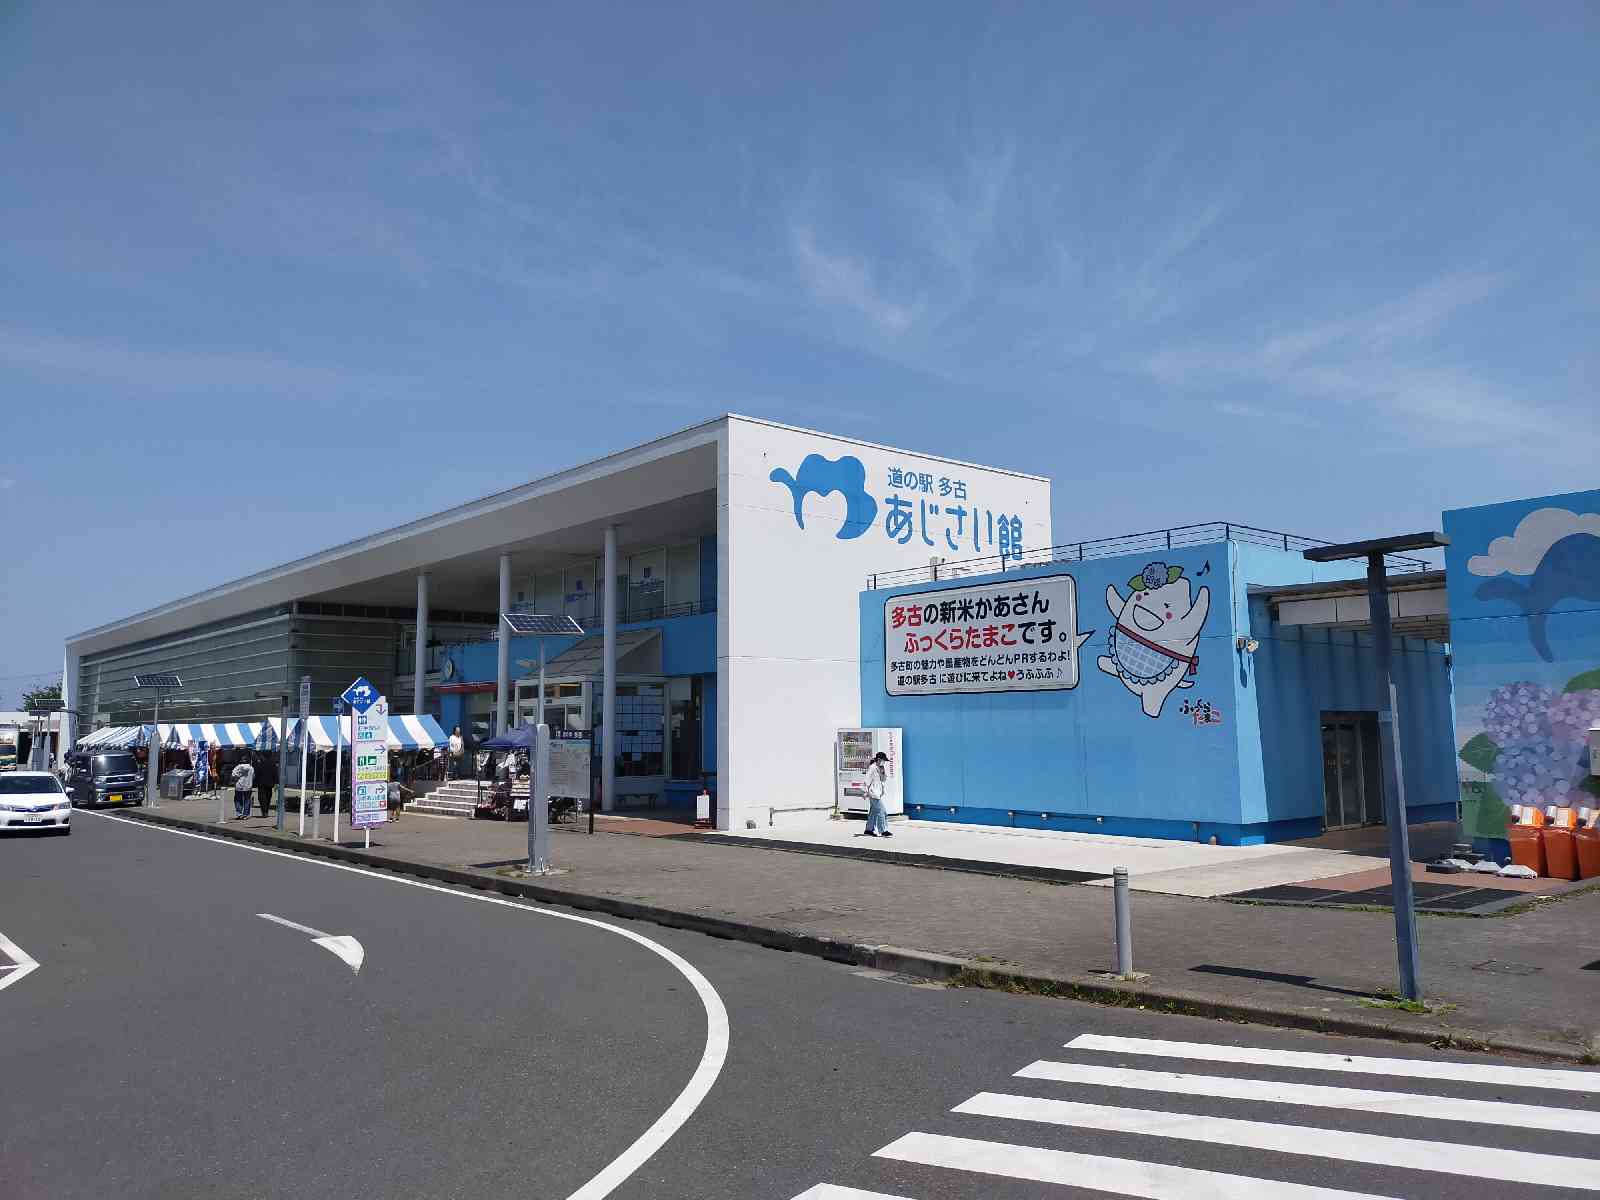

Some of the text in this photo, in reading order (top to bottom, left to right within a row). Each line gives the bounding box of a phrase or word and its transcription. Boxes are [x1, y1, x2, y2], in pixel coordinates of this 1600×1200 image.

[887, 467, 967, 501] 道の駅 多古
[885, 494, 1024, 561] あじさい館
[890, 590, 1050, 630] 多古の新米かあさん
[903, 618, 1067, 654] ふっくらたまこです。
